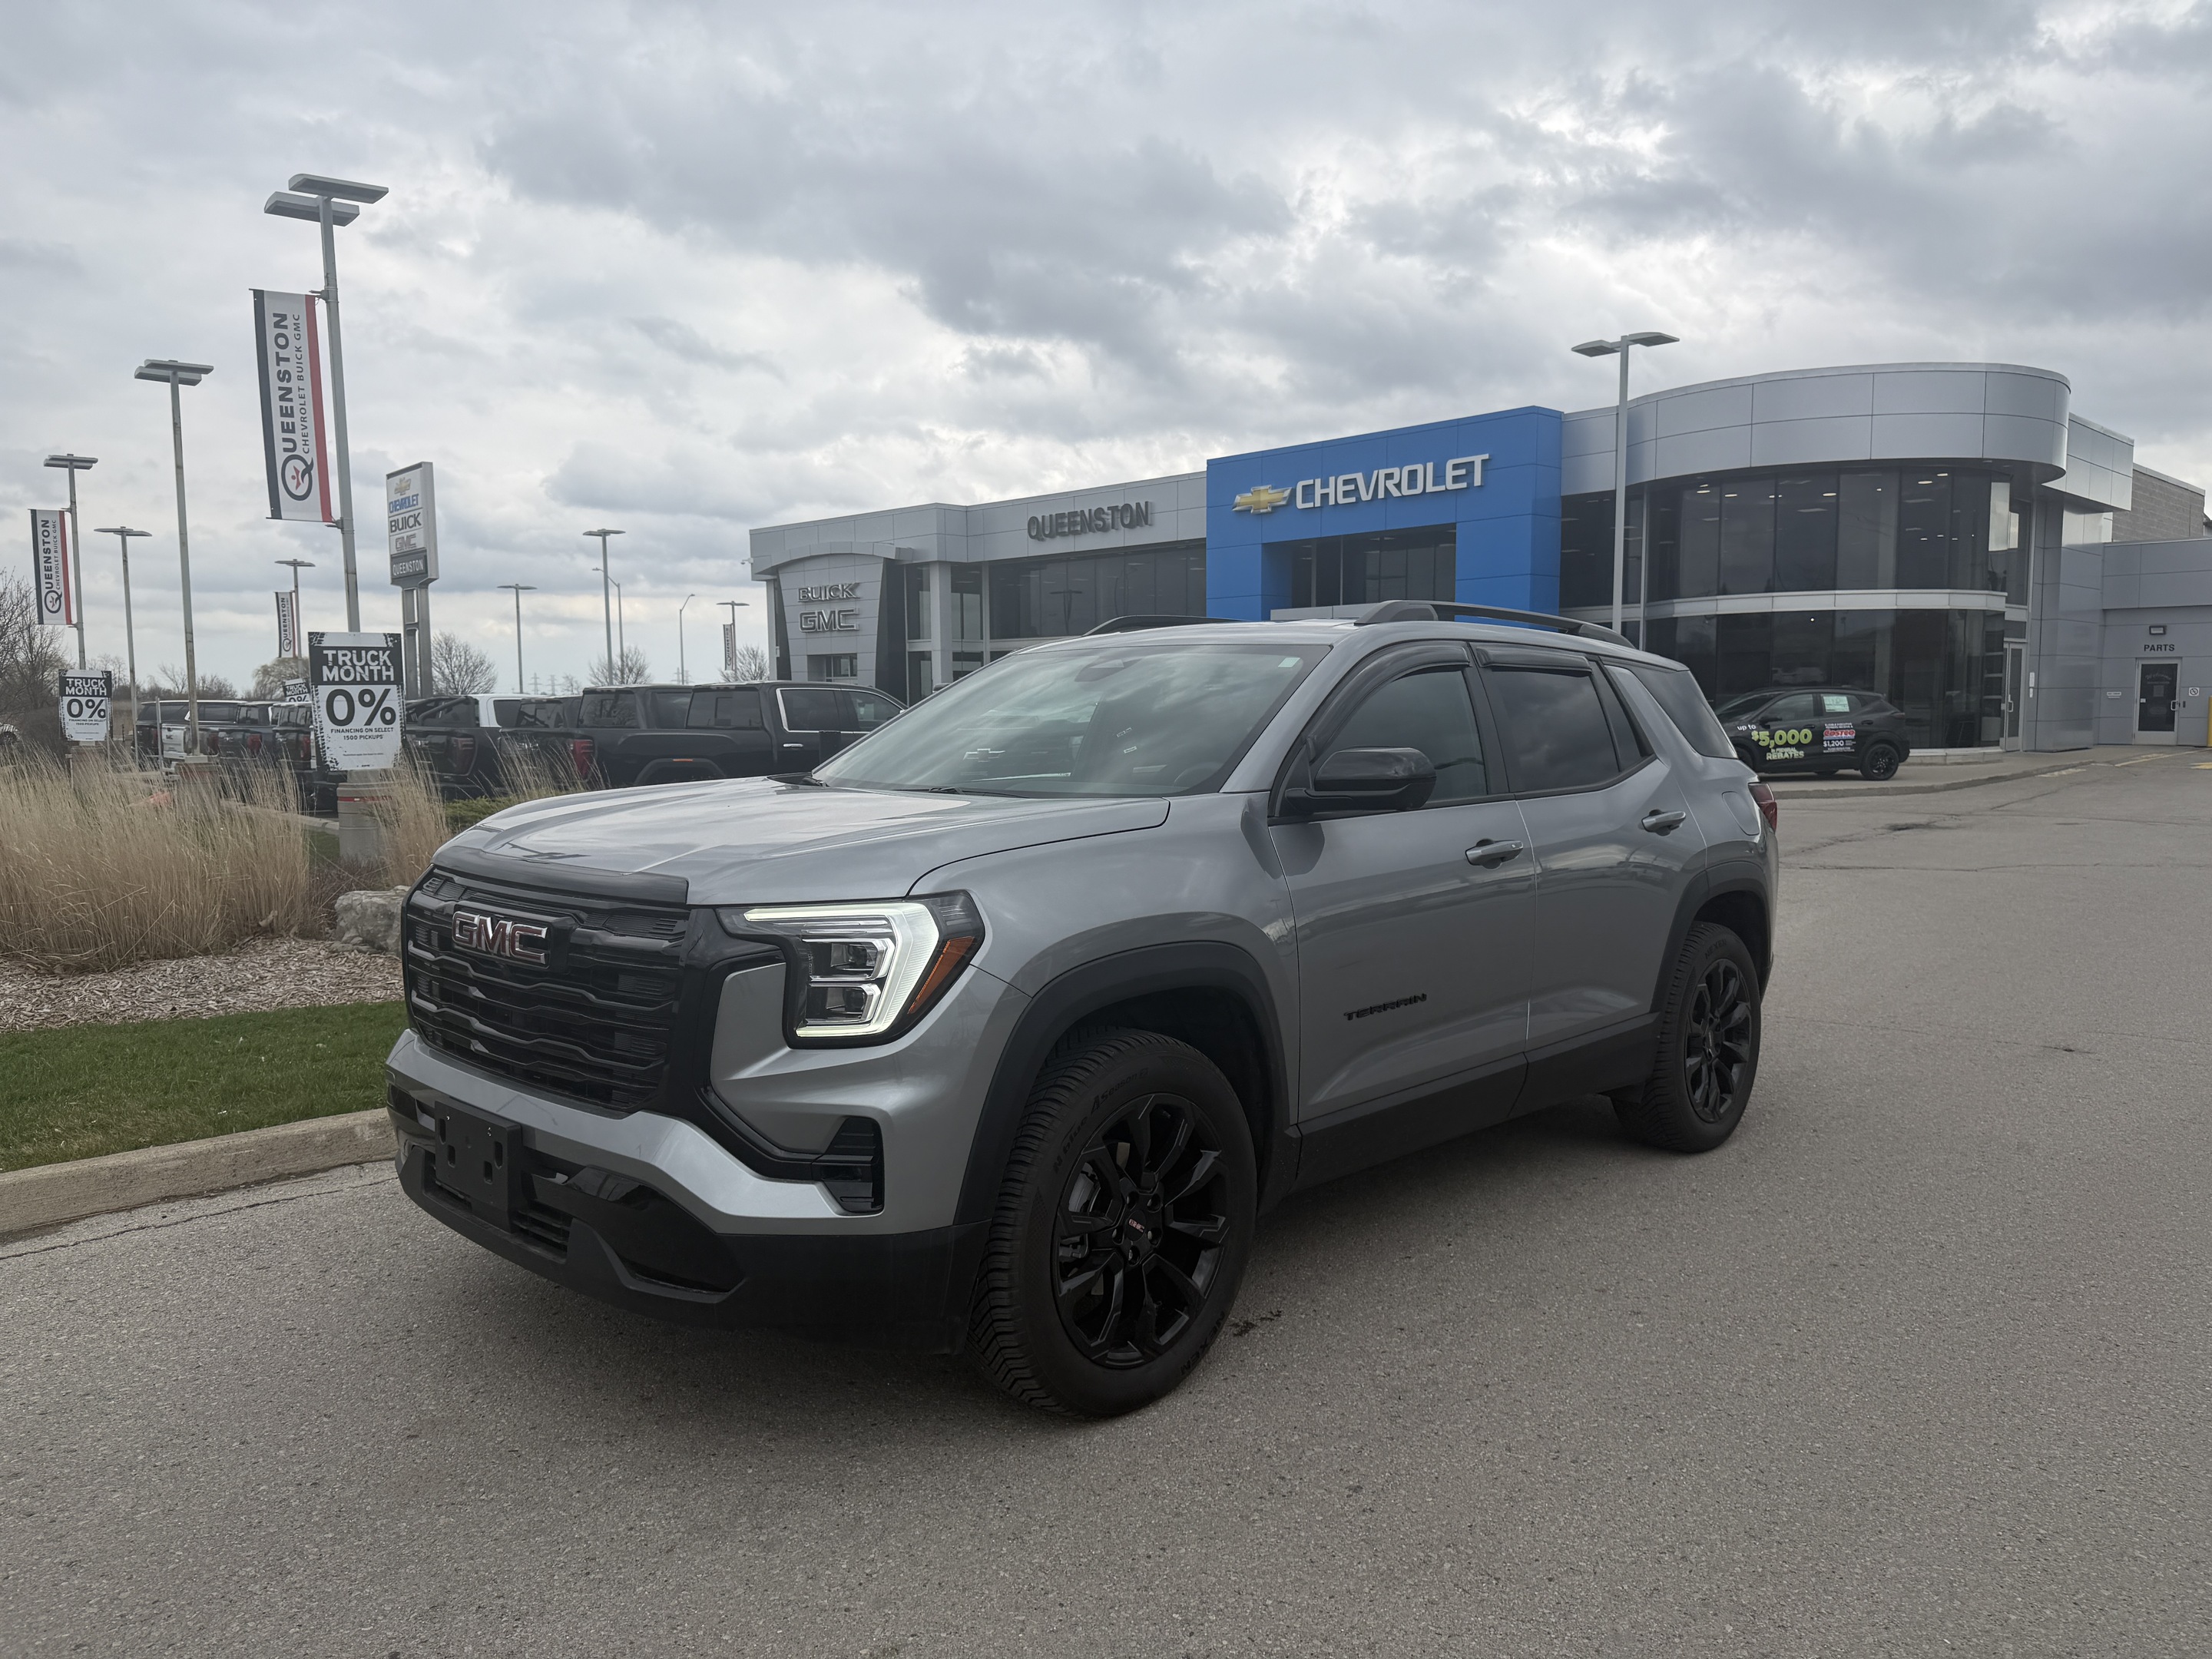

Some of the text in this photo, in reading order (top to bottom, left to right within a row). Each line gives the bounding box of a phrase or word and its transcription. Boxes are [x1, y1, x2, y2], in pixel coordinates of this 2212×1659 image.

[292, 313, 310, 454] CHEVROLET BUICK GMC
[272, 312, 314, 502] QUEENSTON
[1296, 453, 1490, 510] CHEVROLET
[389, 493, 419, 514] CHEVROLET
[390, 512, 422, 533] BUICK
[1026, 501, 1153, 542] QUEENSTON
[395, 533, 417, 551] GMC
[41, 519, 63, 614] QUEENSTON
[392, 558, 423, 576] QUEENSTON
[798, 582, 860, 602] BUICK
[799, 608, 859, 634] GMC
[323, 650, 392, 667] TRUCK
[2144, 644, 2175, 652] PARTS
[65, 677, 106, 688] TRUCK
[322, 665, 395, 682] MONTH
[65, 686, 108, 696] MONTH
[66, 698, 106, 719] 0%
[326, 688, 397, 727] 0%
[1751, 728, 1813, 748] $5,000
[1766, 750, 1805, 761] REBATES
[452, 911, 548, 965] GMC
[1343, 993, 1428, 1022] TERRAIN
